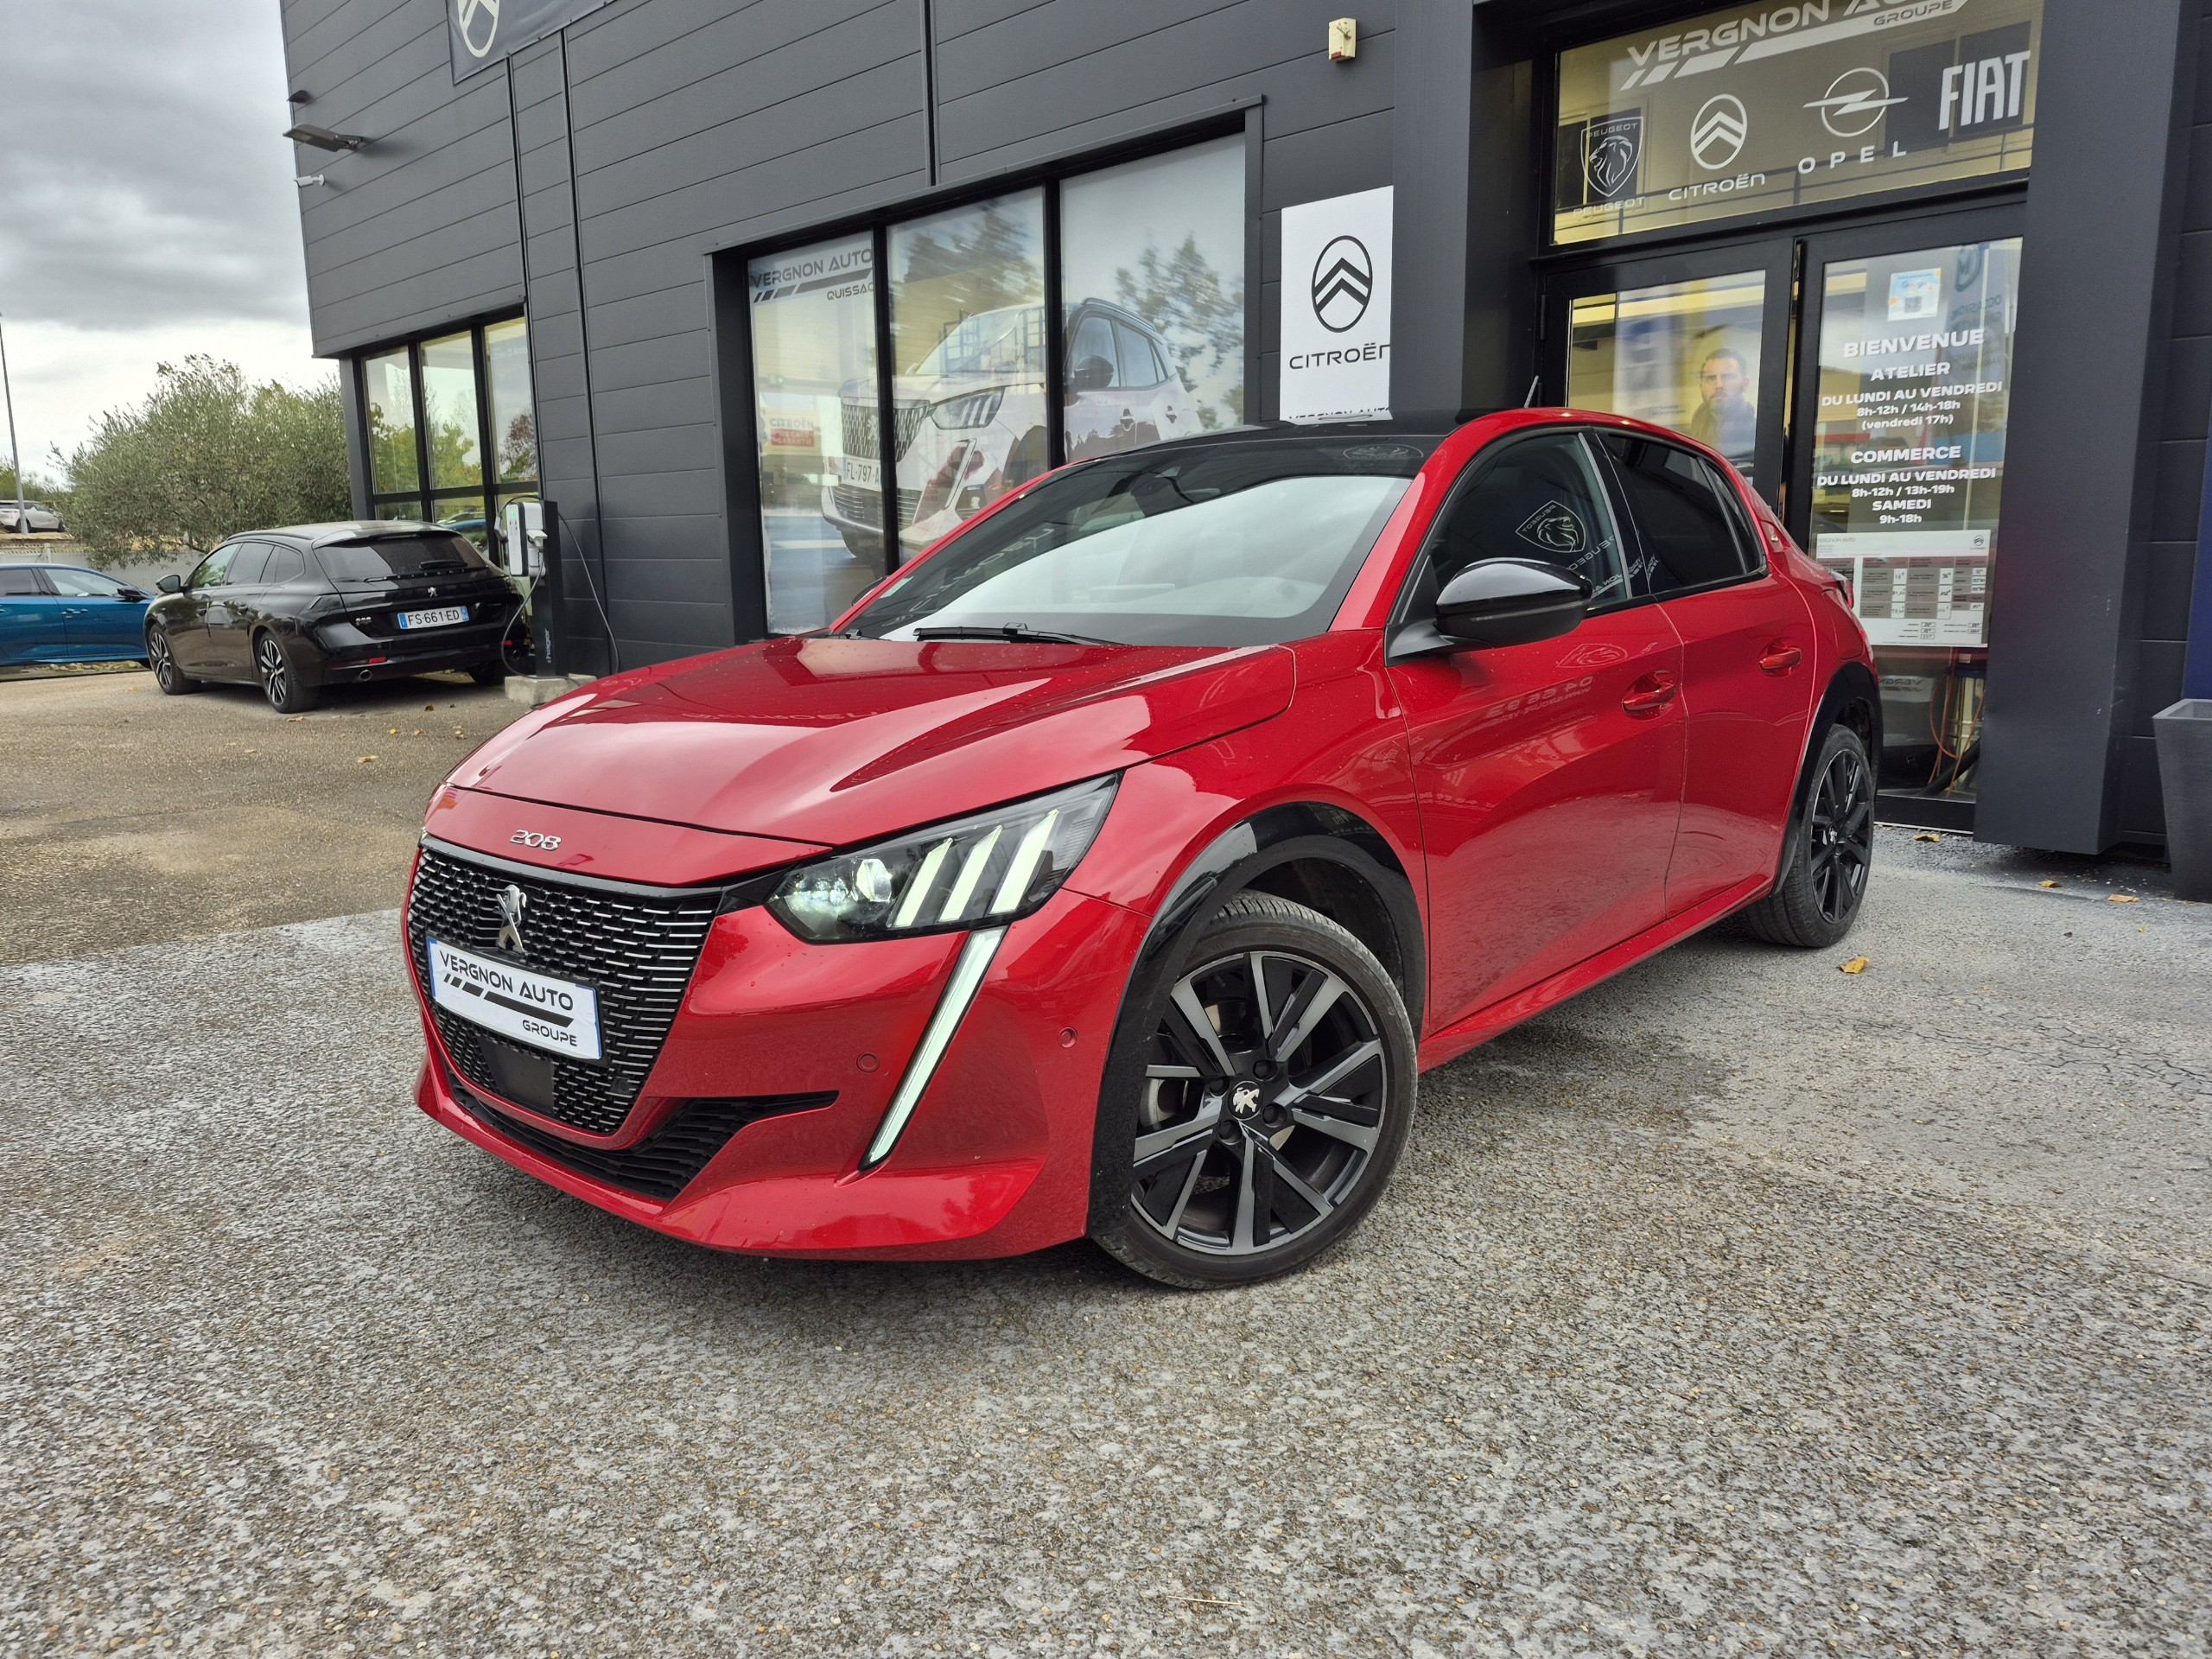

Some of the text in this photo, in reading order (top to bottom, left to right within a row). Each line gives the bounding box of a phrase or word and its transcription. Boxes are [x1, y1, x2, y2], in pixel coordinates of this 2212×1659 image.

[1873, 1, 1953, 26] GROUPE
[1627, 0, 1829, 67] VERGNON
[1938, 50, 2031, 130] FIAT
[1587, 123, 1638, 137] PEUGEOT
[1798, 145, 1906, 174] OPEL
[1573, 197, 1645, 216] PEUGEOT
[752, 249, 872, 288] VERGNON AUTO
[1843, 328, 1985, 358] BIENVENUE
[1871, 362, 1951, 382] ATELIER
[1821, 381, 2003, 406] DU LUNDI AU VENDREDI
[1857, 404, 1898, 416] 8h-12h
[1910, 400, 1961, 414] 14h-18h
[1861, 414, 1954, 430] (vendredi 17h)
[1851, 445, 1961, 464] COMMERCE
[1817, 467, 1996, 486] DU LUNDI AU VENDREDI
[1852, 486, 1893, 498] 8h-12h
[1904, 484, 1955, 496] 13h-19h
[1872, 499, 1931, 512] SAMEDI
[1879, 513, 1922, 524] 9h-18h
[509, 830, 562, 852] 208
[439, 950, 574, 1012] VERGNON AUTO
[522, 1020, 578, 1047] GROUPE
